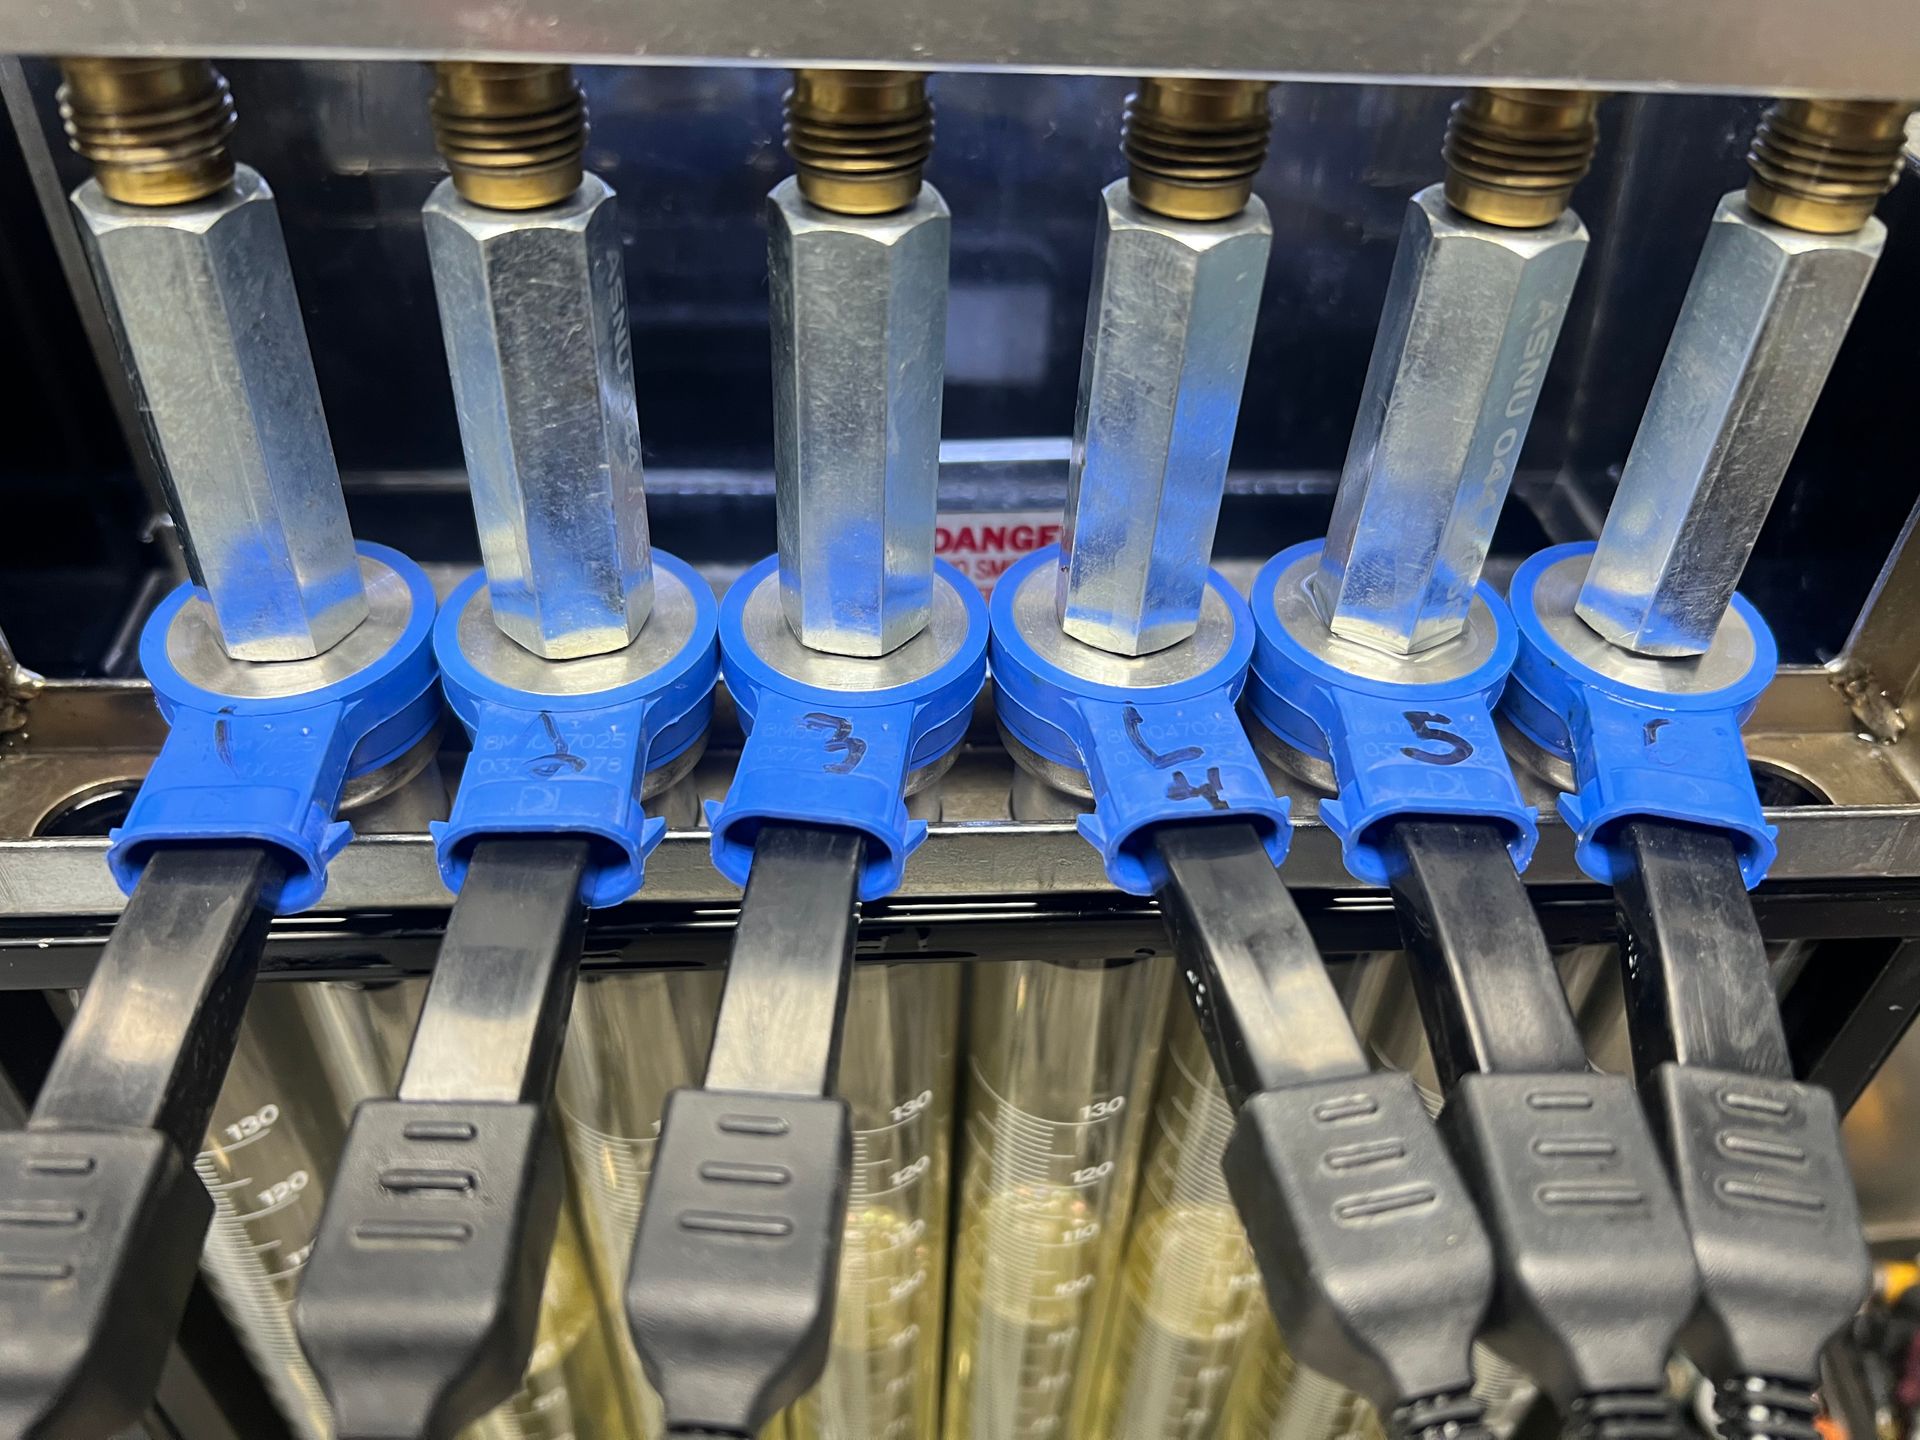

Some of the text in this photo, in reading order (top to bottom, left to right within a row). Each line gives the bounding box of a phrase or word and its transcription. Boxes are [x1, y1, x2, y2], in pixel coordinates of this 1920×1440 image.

[606, 249, 630, 375] ASNU
[1504, 300, 1559, 420] ASNU
[935, 524, 1063, 554] DANGE
[800, 711, 868, 774] 3
[1402, 710, 1474, 766] 5
[1167, 766, 1230, 810] 4
[225, 1103, 280, 1141] 130
[890, 1089, 933, 1122] 130
[1079, 1095, 1126, 1121] 130
[889, 1154, 931, 1186] 120
[1071, 1160, 1115, 1184] 120
[1061, 1222, 1099, 1244] 110
